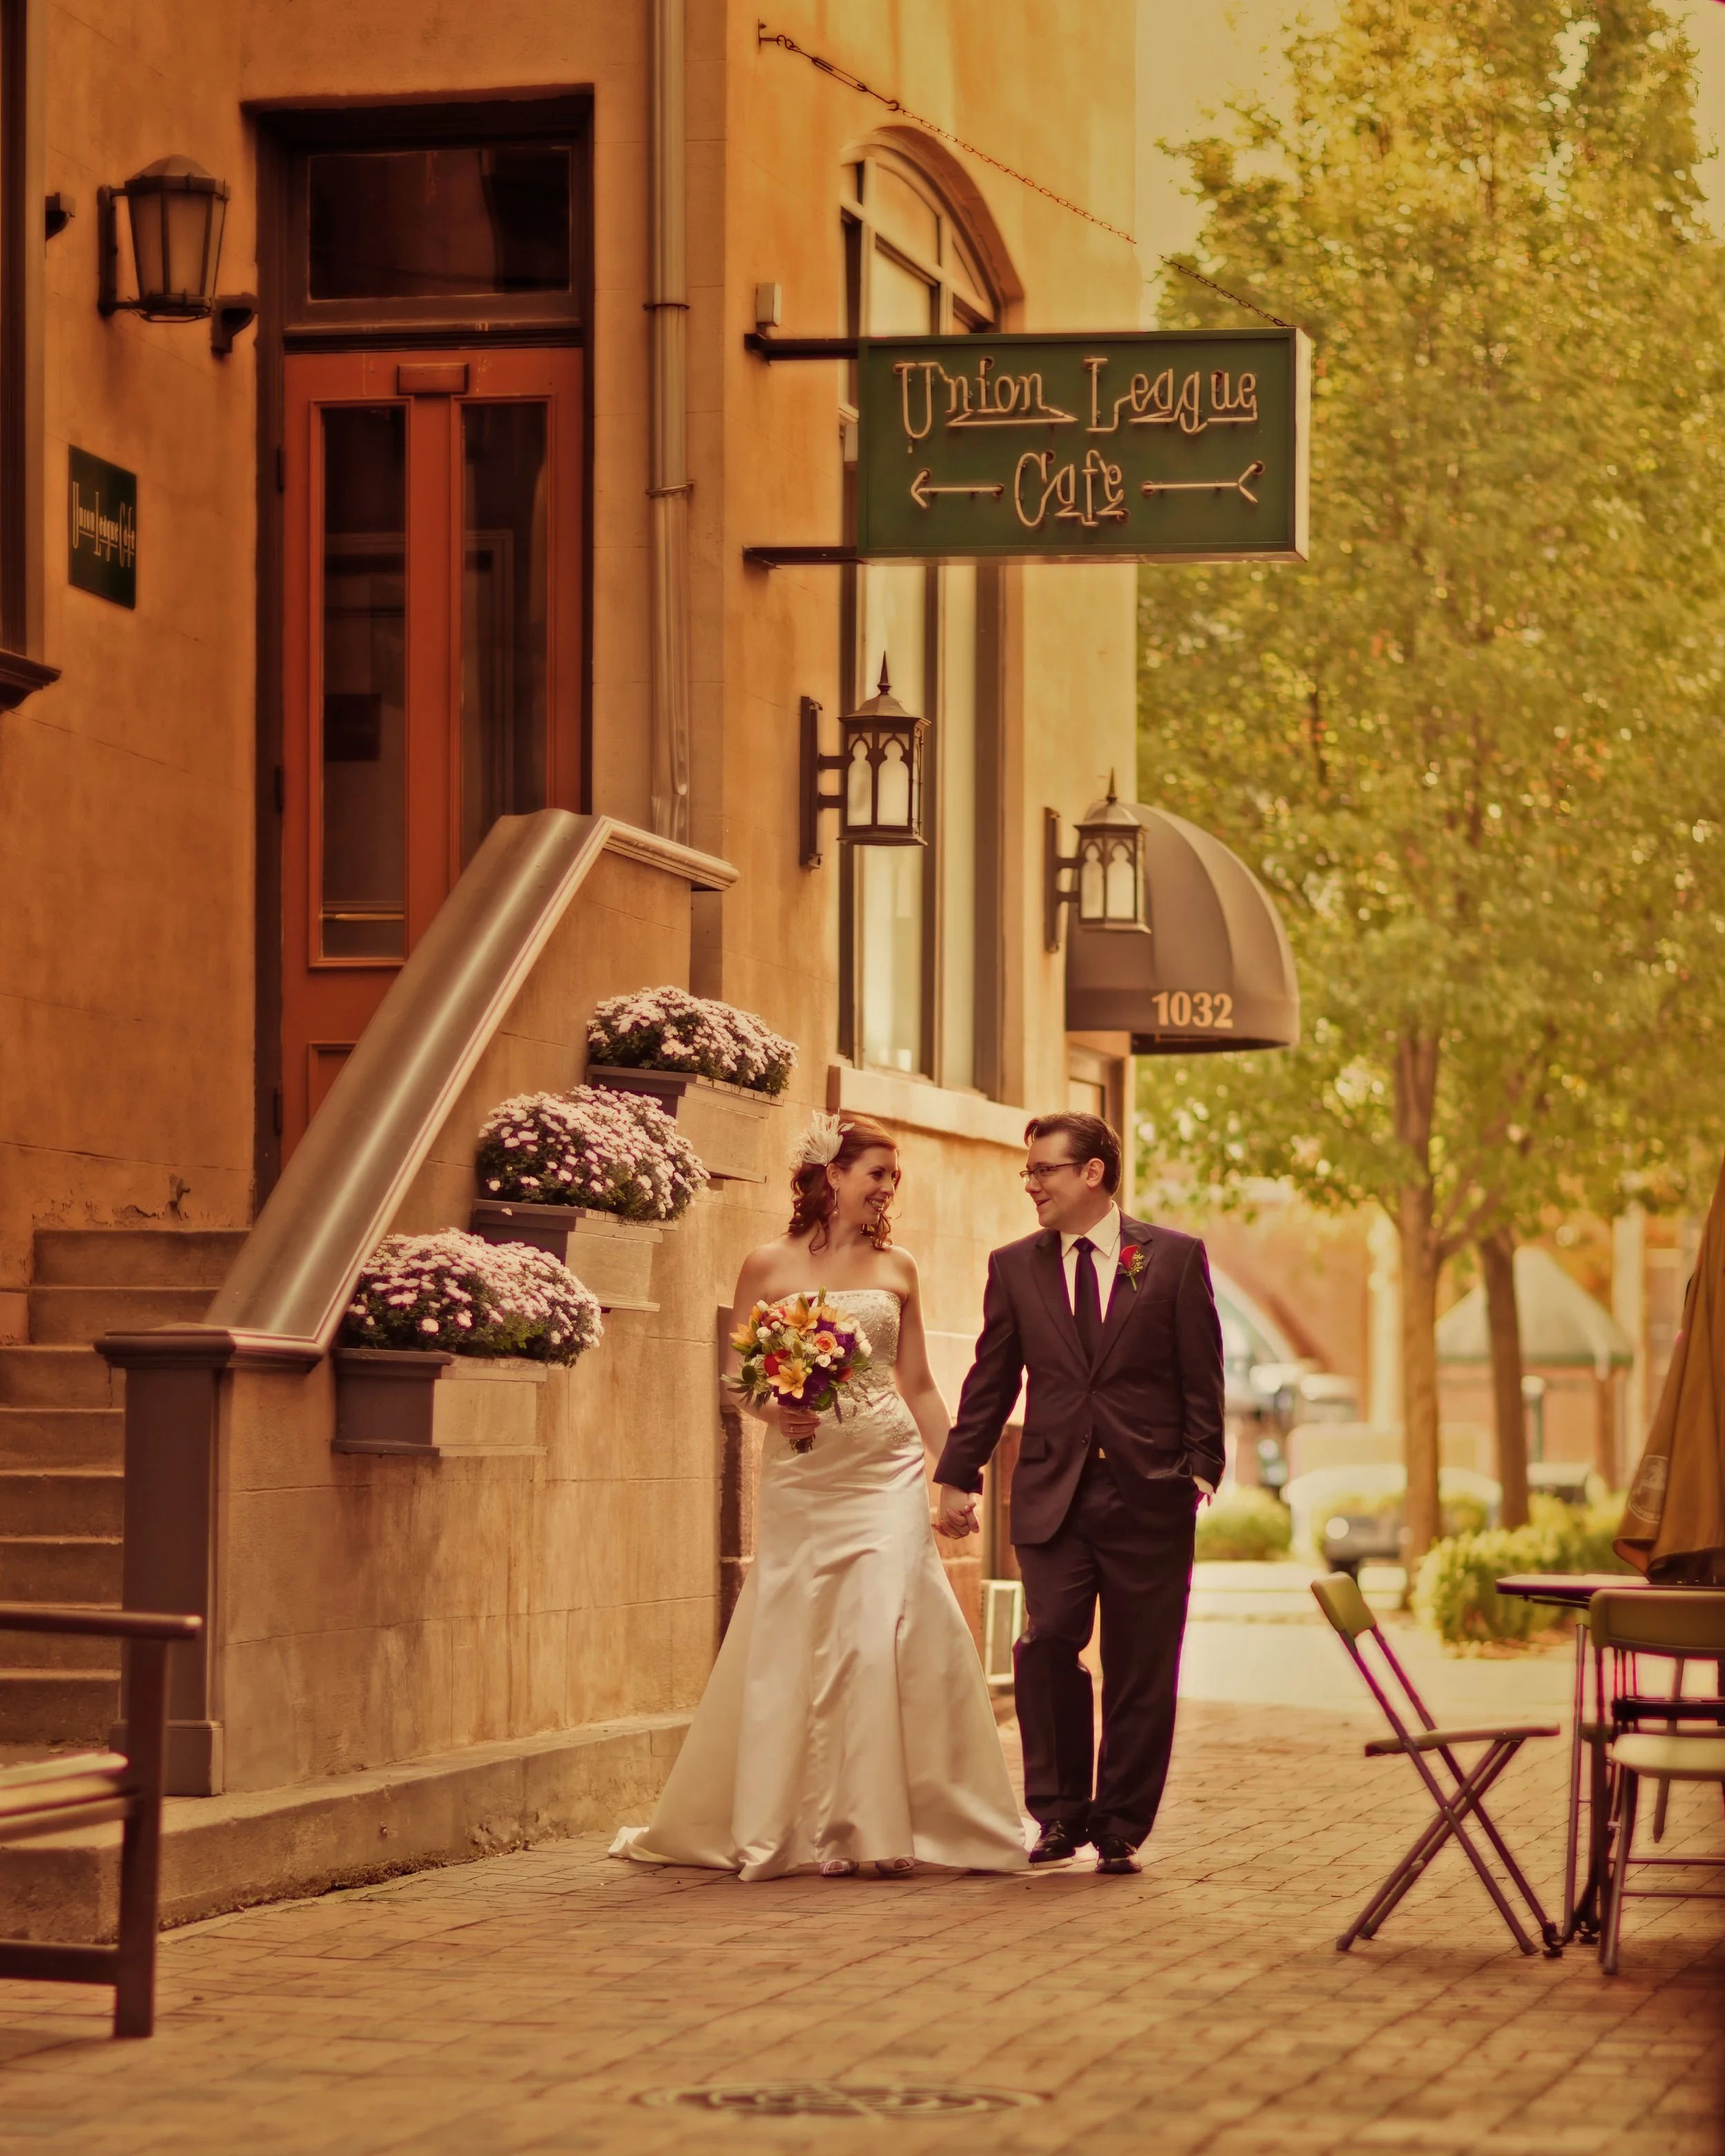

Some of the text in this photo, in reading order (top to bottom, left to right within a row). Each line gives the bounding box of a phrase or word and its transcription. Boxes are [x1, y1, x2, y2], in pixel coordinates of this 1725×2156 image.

[894, 357, 1258, 440] Union League
[72, 481, 95, 549] Union
[94, 491, 118, 562] League
[1014, 450, 1127, 526] Cafe
[1151, 991, 1234, 1028] 1032
